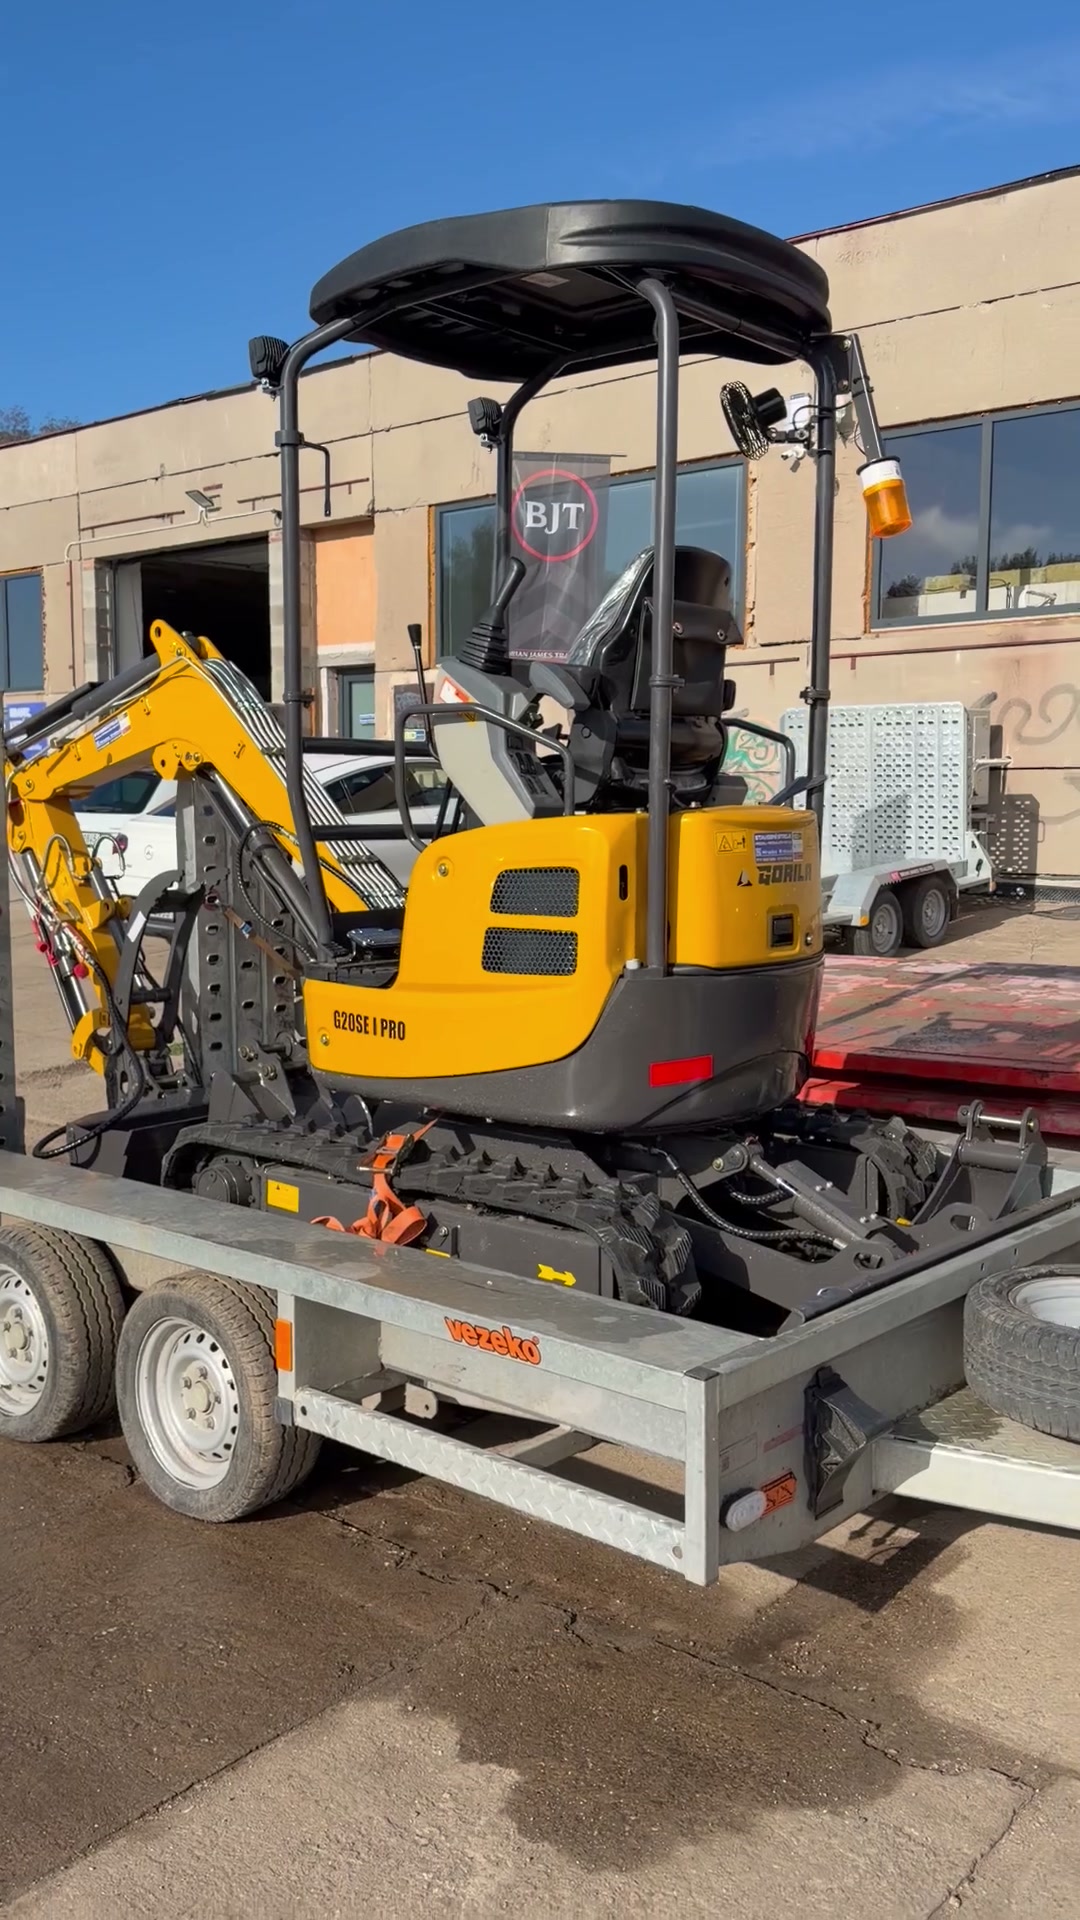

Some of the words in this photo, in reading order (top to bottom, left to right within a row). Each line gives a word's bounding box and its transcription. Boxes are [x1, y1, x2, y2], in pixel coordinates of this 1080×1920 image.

[525, 501, 585, 534] BJT
[529, 651, 554, 659] JAMES
[757, 863, 812, 885] GORILA
[333, 1010, 369, 1035] G20SE
[380, 1018, 406, 1041] PRO
[444, 1316, 541, 1365] vezeko
